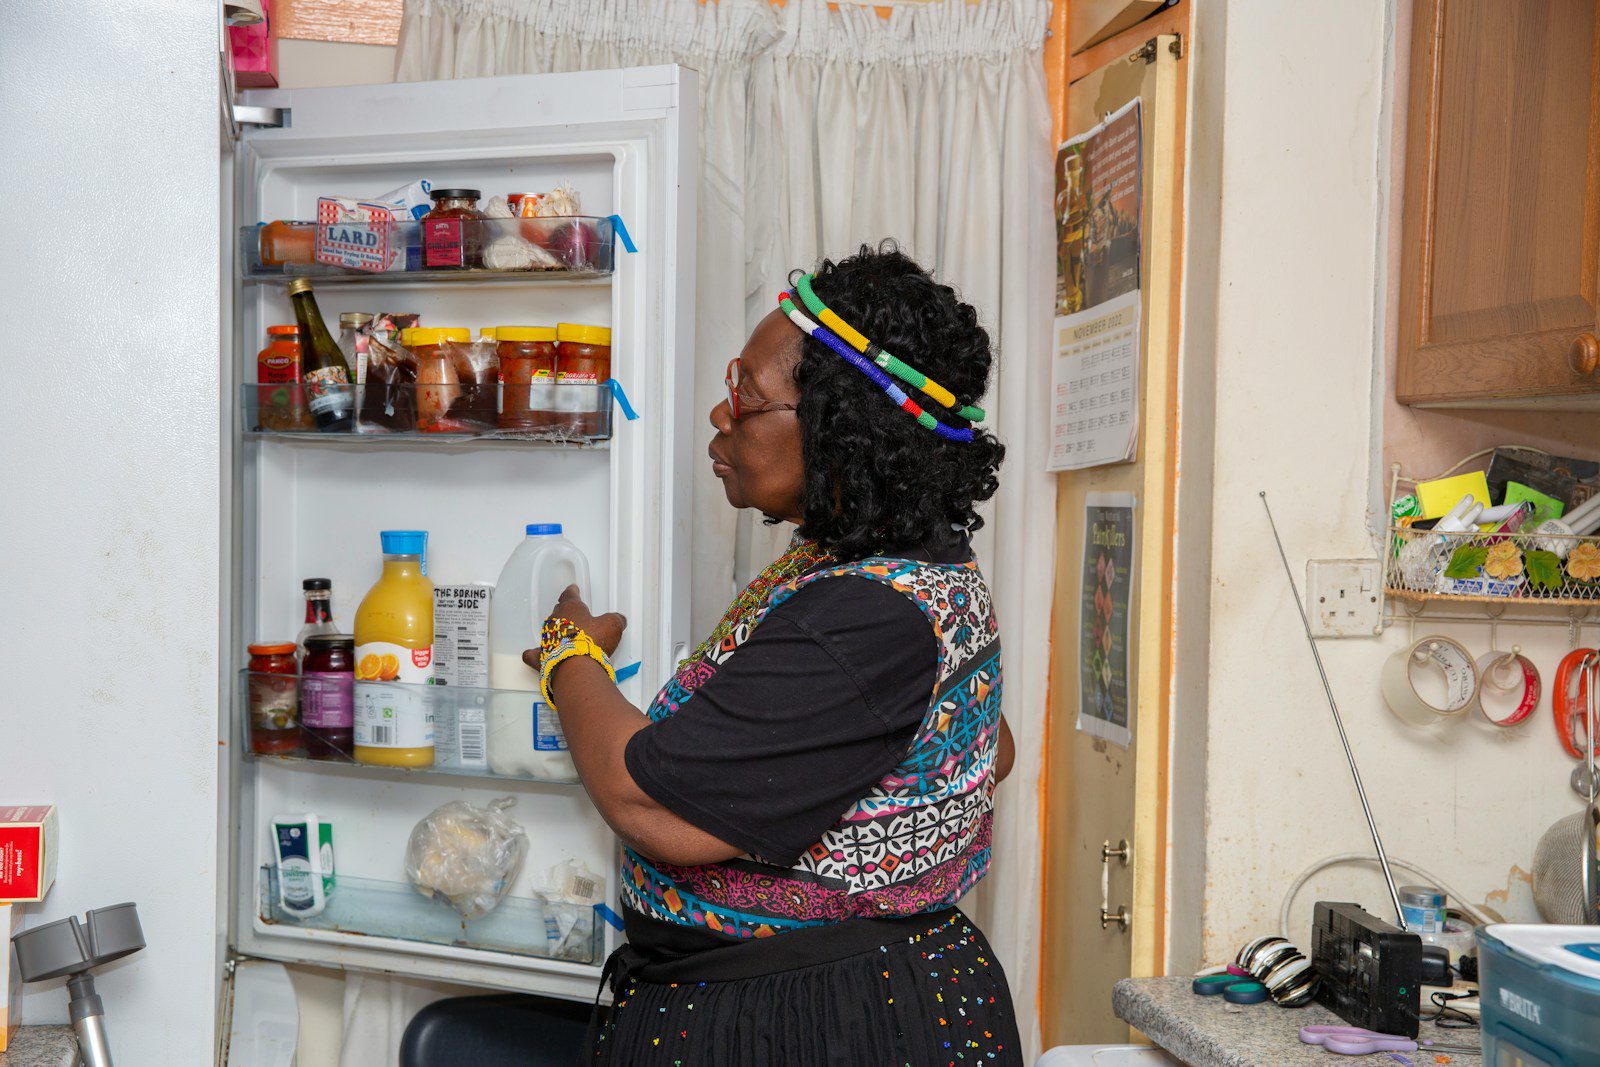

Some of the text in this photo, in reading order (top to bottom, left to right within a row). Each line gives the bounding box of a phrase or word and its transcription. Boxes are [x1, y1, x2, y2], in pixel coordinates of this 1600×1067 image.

[327, 226, 379, 247] LARD
[1073, 313, 1122, 340] NOVEMBER 2022
[434, 587, 487, 600] THE BORING
[457, 598, 480, 609] SIDE
